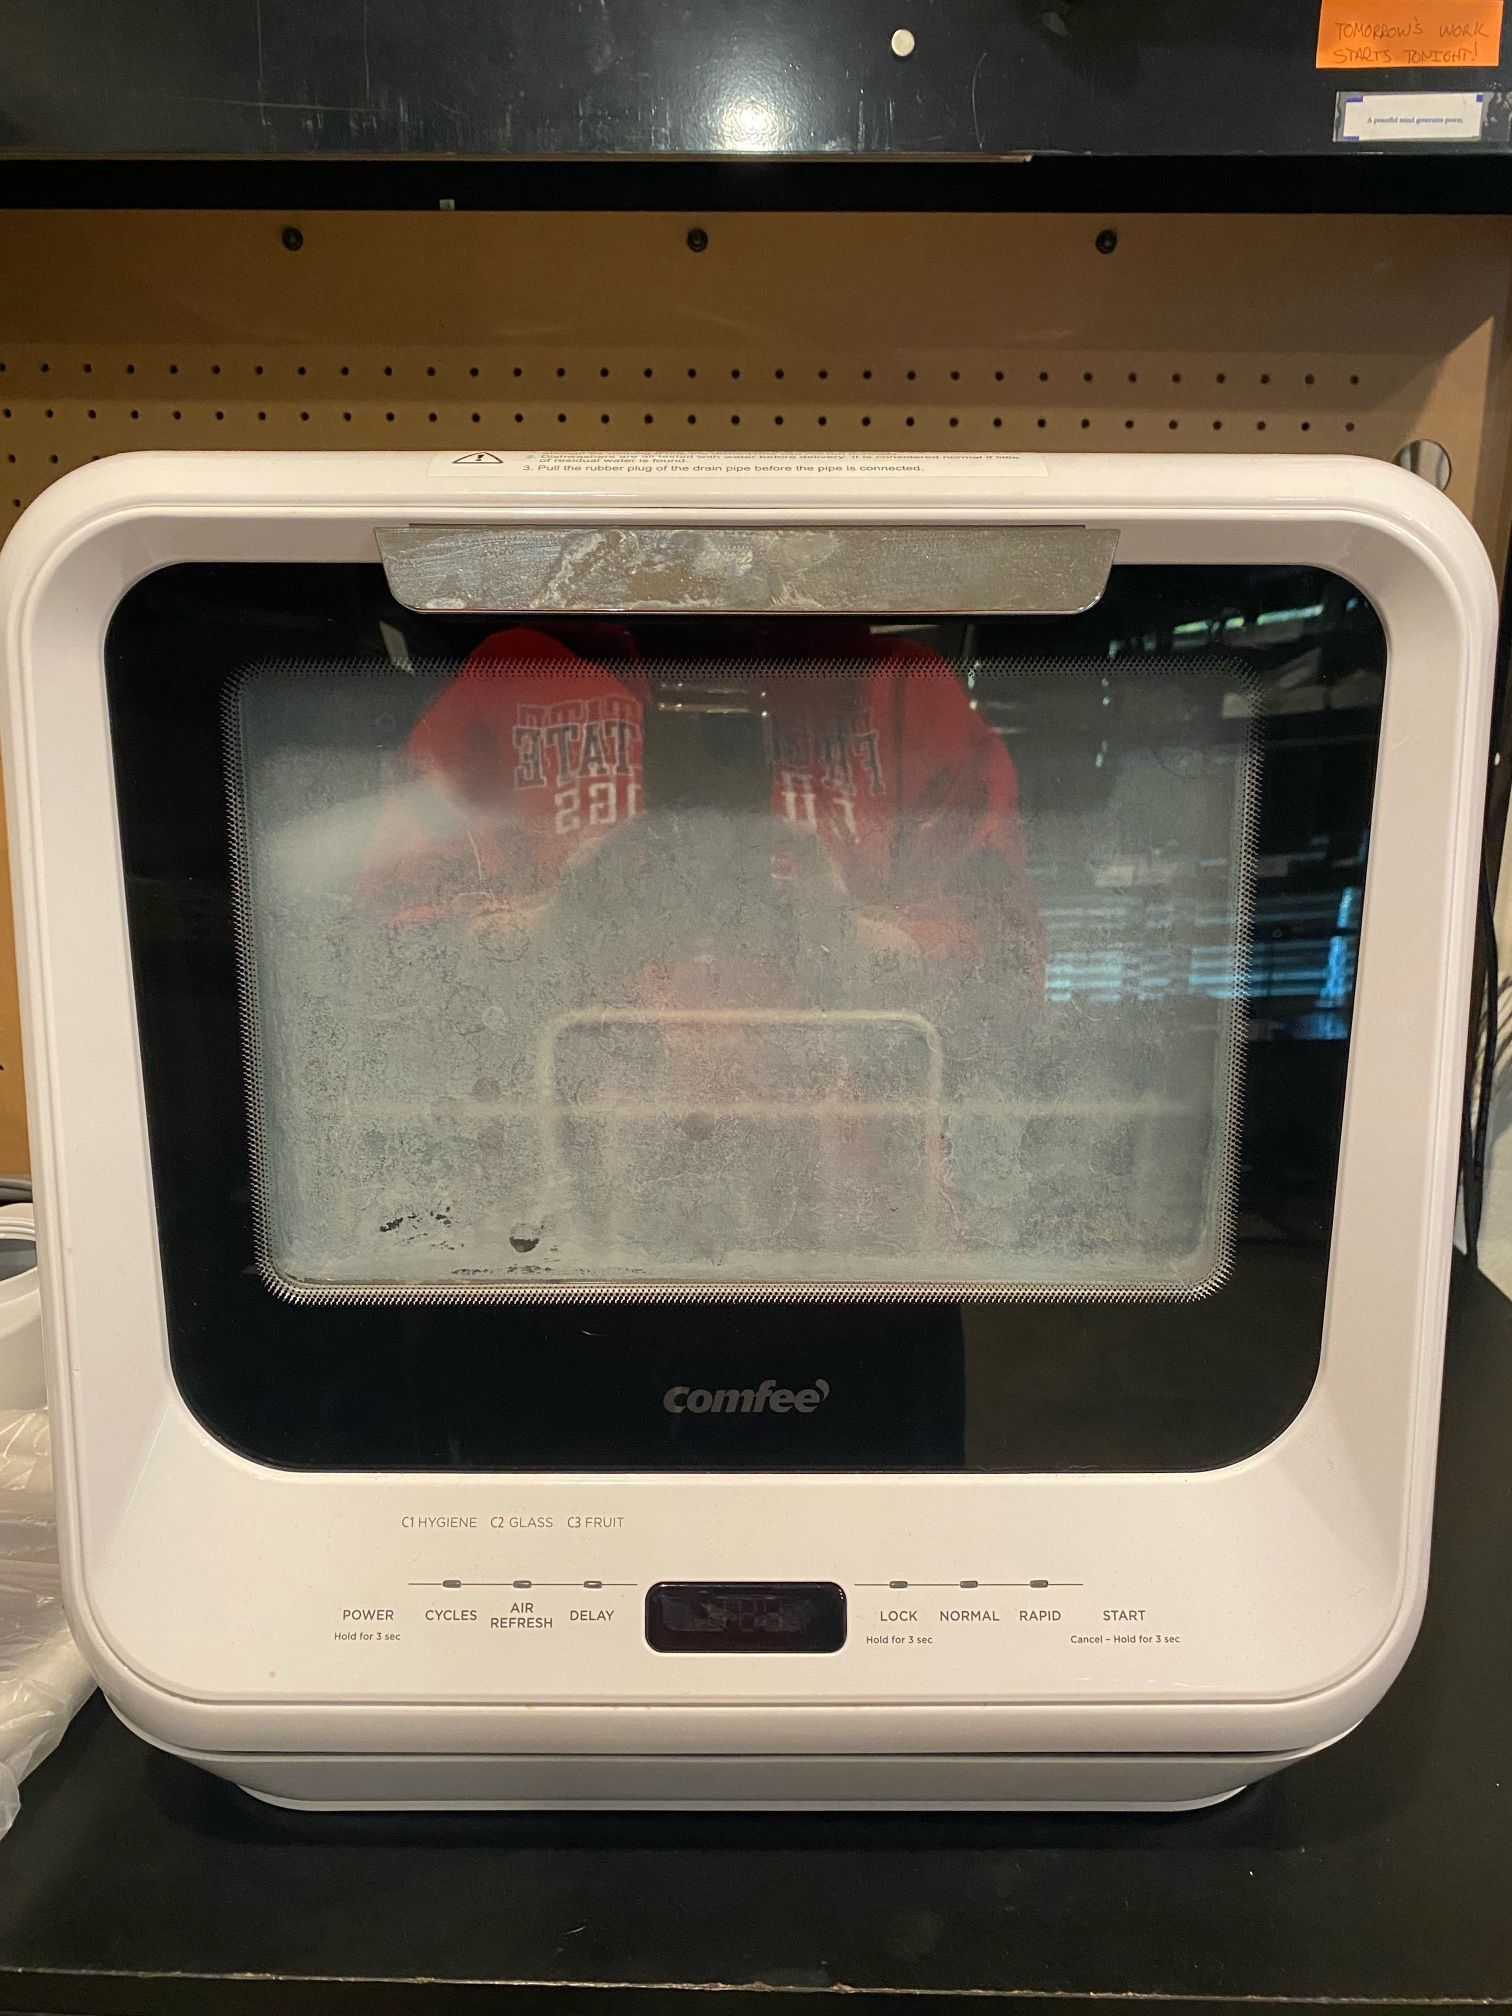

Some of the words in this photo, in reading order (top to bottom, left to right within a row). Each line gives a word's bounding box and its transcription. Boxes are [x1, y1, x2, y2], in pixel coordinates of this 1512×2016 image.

[1335, 17, 1424, 40] TOMORROW'S
[1439, 21, 1489, 39] WORK
[1333, 48, 1392, 64] STARTS
[1404, 42, 1479, 64] TONIGHT!
[1374, 117, 1398, 125] peaceful
[628, 465, 652, 473] plug
[726, 465, 751, 473] pipe
[818, 465, 843, 473] pipe
[401, 1516, 415, 1528] C1
[418, 1516, 478, 1528] HYGIENE
[490, 1516, 504, 1528] C2
[509, 1516, 554, 1528] GLASS
[567, 1516, 581, 1528] C3
[585, 1516, 625, 1528] FRUIT
[510, 1602, 534, 1614] AIR
[342, 1609, 394, 1621] POWER
[425, 1609, 478, 1621] CYCLES
[569, 1610, 615, 1622] DELAY
[880, 1610, 918, 1622] LOCK
[939, 1610, 1000, 1622] NORMAL
[1019, 1610, 1062, 1622] RAPID
[1102, 1609, 1146, 1622] START
[490, 1617, 553, 1629] REFRESH
[334, 1631, 357, 1641] Hold
[359, 1631, 374, 1641] for
[376, 1631, 383, 1641] 3
[385, 1633, 401, 1641] sec
[866, 1635, 889, 1645] Hold
[891, 1635, 906, 1645] for
[908, 1635, 915, 1645] 3
[917, 1637, 933, 1645] sec
[1070, 1634, 1103, 1644] Cancel
[1113, 1634, 1137, 1644] Hold
[1138, 1634, 1153, 1644] for
[1155, 1634, 1162, 1644] 3
[1164, 1636, 1181, 1644] sec
